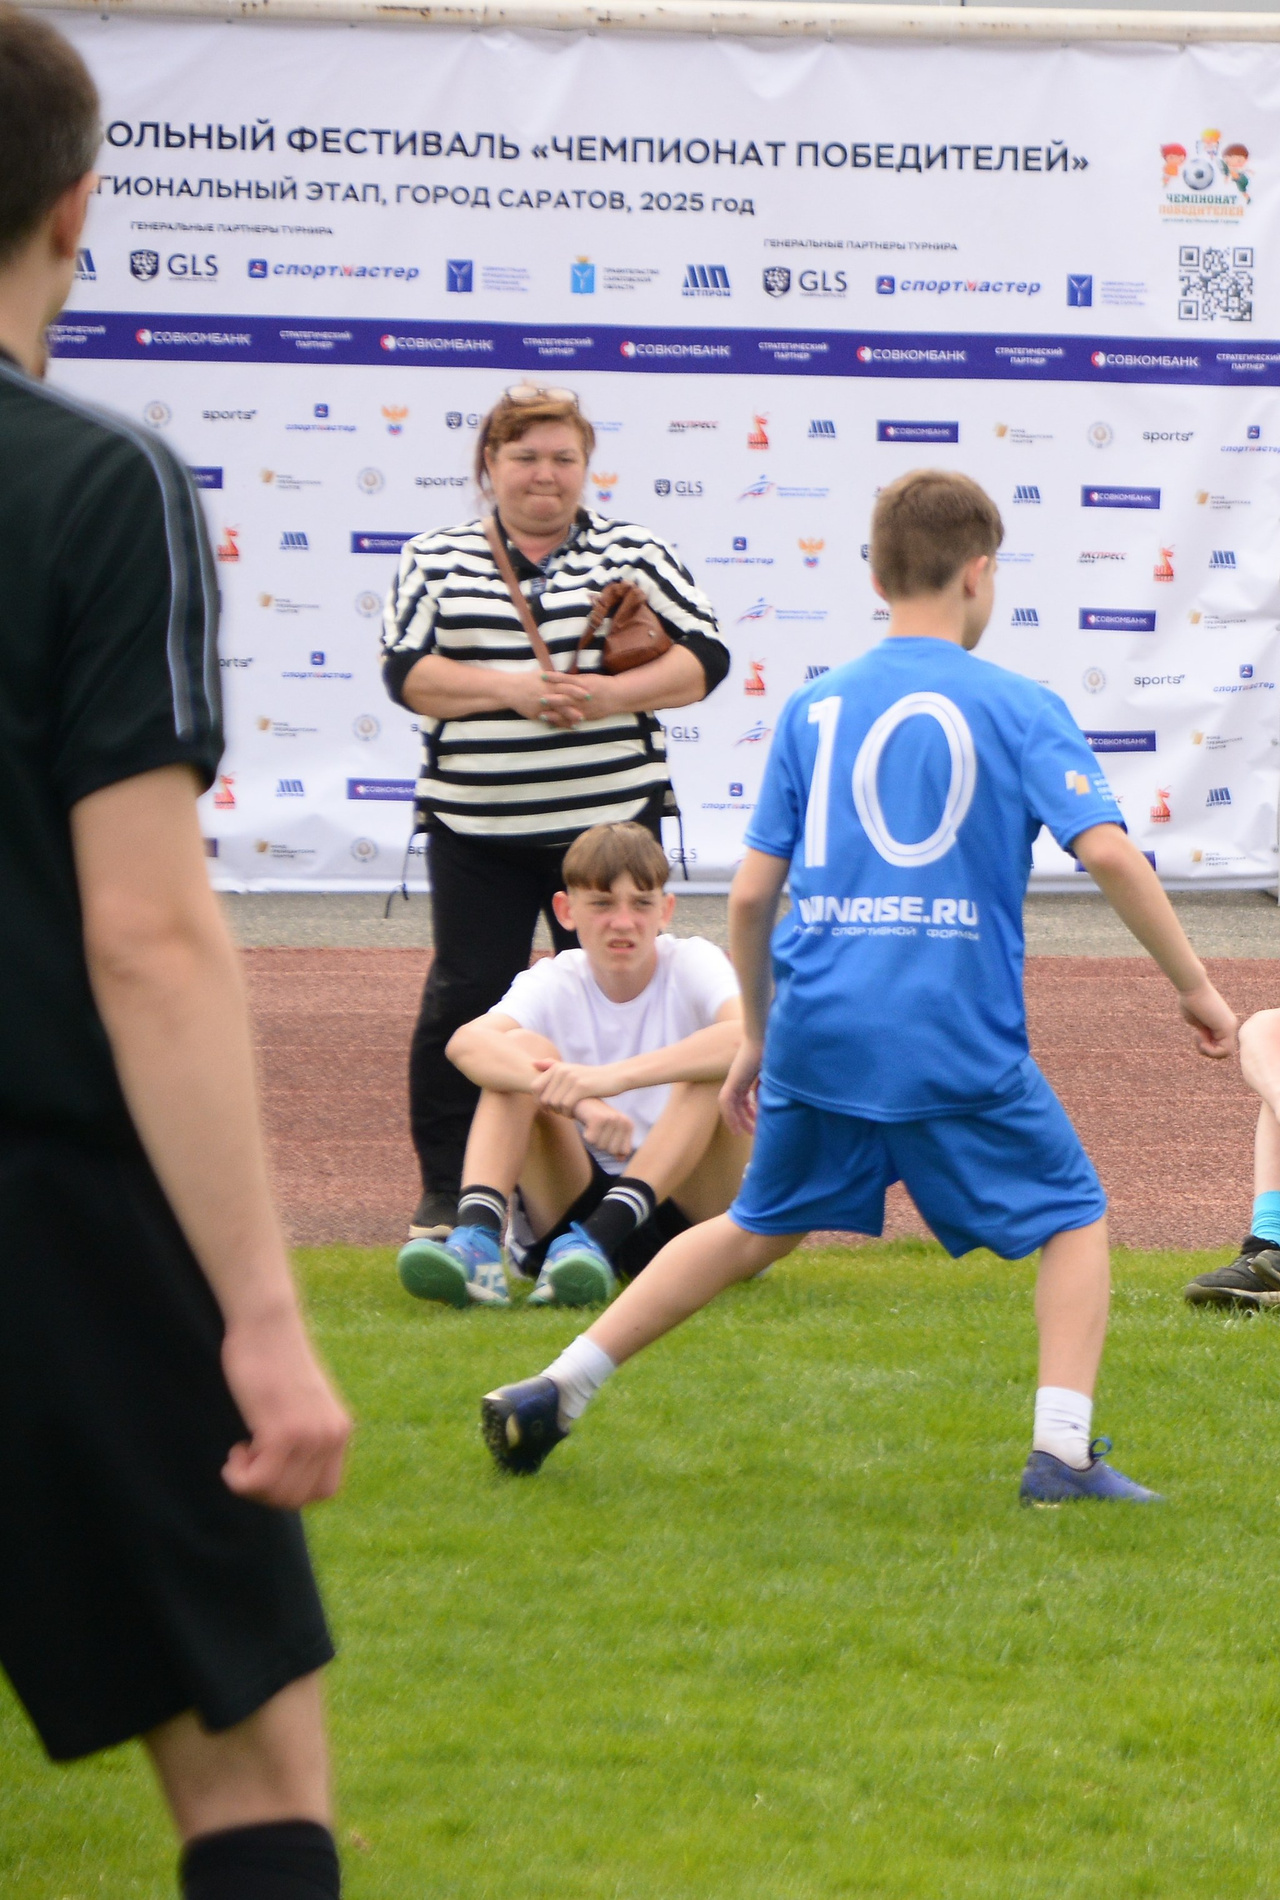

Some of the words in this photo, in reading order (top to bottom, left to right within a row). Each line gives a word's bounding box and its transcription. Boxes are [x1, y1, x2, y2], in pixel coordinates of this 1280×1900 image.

[106, 118, 275, 151] ОЛЬНЫЙ
[287, 126, 520, 160] ФЕСТИВАЛЬ
[531, 134, 786, 168] «ЧЕМПИОНАТ
[797, 139, 1089, 173] ПОБЕДИТЕЛЕЙ»
[90, 174, 298, 200] ГИОНАЛЬНЫЙ
[306, 182, 387, 207] ЭТАП,
[396, 184, 491, 209] ГОРОД
[498, 187, 632, 214] САРАТОВ,
[640, 192, 704, 212] 2025
[1166, 193, 1238, 204] ЧЕМПИОНАТ
[1159, 204, 1245, 217] ПОБЕДИТЕЛЕЙ
[130, 220, 214, 232] ГЕНЕРАЛЬНЫЕ
[217, 223, 278, 233] ПАРТНЕРЫ
[763, 238, 844, 249] ГЕНЕРАЛЬНЫЕ
[846, 240, 905, 251] ПАРТНЕРЫ
[908, 242, 958, 253] ТУРНИРА
[167, 252, 219, 277] GLS
[272, 261, 420, 281] спортмастер
[799, 269, 848, 293] GLS
[900, 278, 1042, 296] спортмастер
[152, 331, 252, 346] СОВКОМБАНК
[397, 336, 494, 351] СОВКОМБАНК
[636, 343, 731, 356] СОВКОМБАНК
[873, 348, 966, 361] СОВКОМБАНК
[995, 346, 1063, 356] СТРАТЕГИЧЕСКИЙ
[1010, 356, 1046, 365] ПАРТНЕР
[1107, 353, 1199, 368] СОВКОМБАНК
[1231, 362, 1265, 370] ПАРТНЕР
[675, 481, 703, 494] GLS
[1099, 493, 1152, 502] СОВКОМБАНК
[1096, 616, 1148, 625] СОВКОМБАНК
[671, 727, 699, 740] GLS
[1093, 737, 1147, 746] СОВКОМБАНК
[804, 691, 977, 868] 10
[831, 926, 917, 937] СПОРТИВНОЙ
[926, 928, 979, 941] ФОРМЫ
